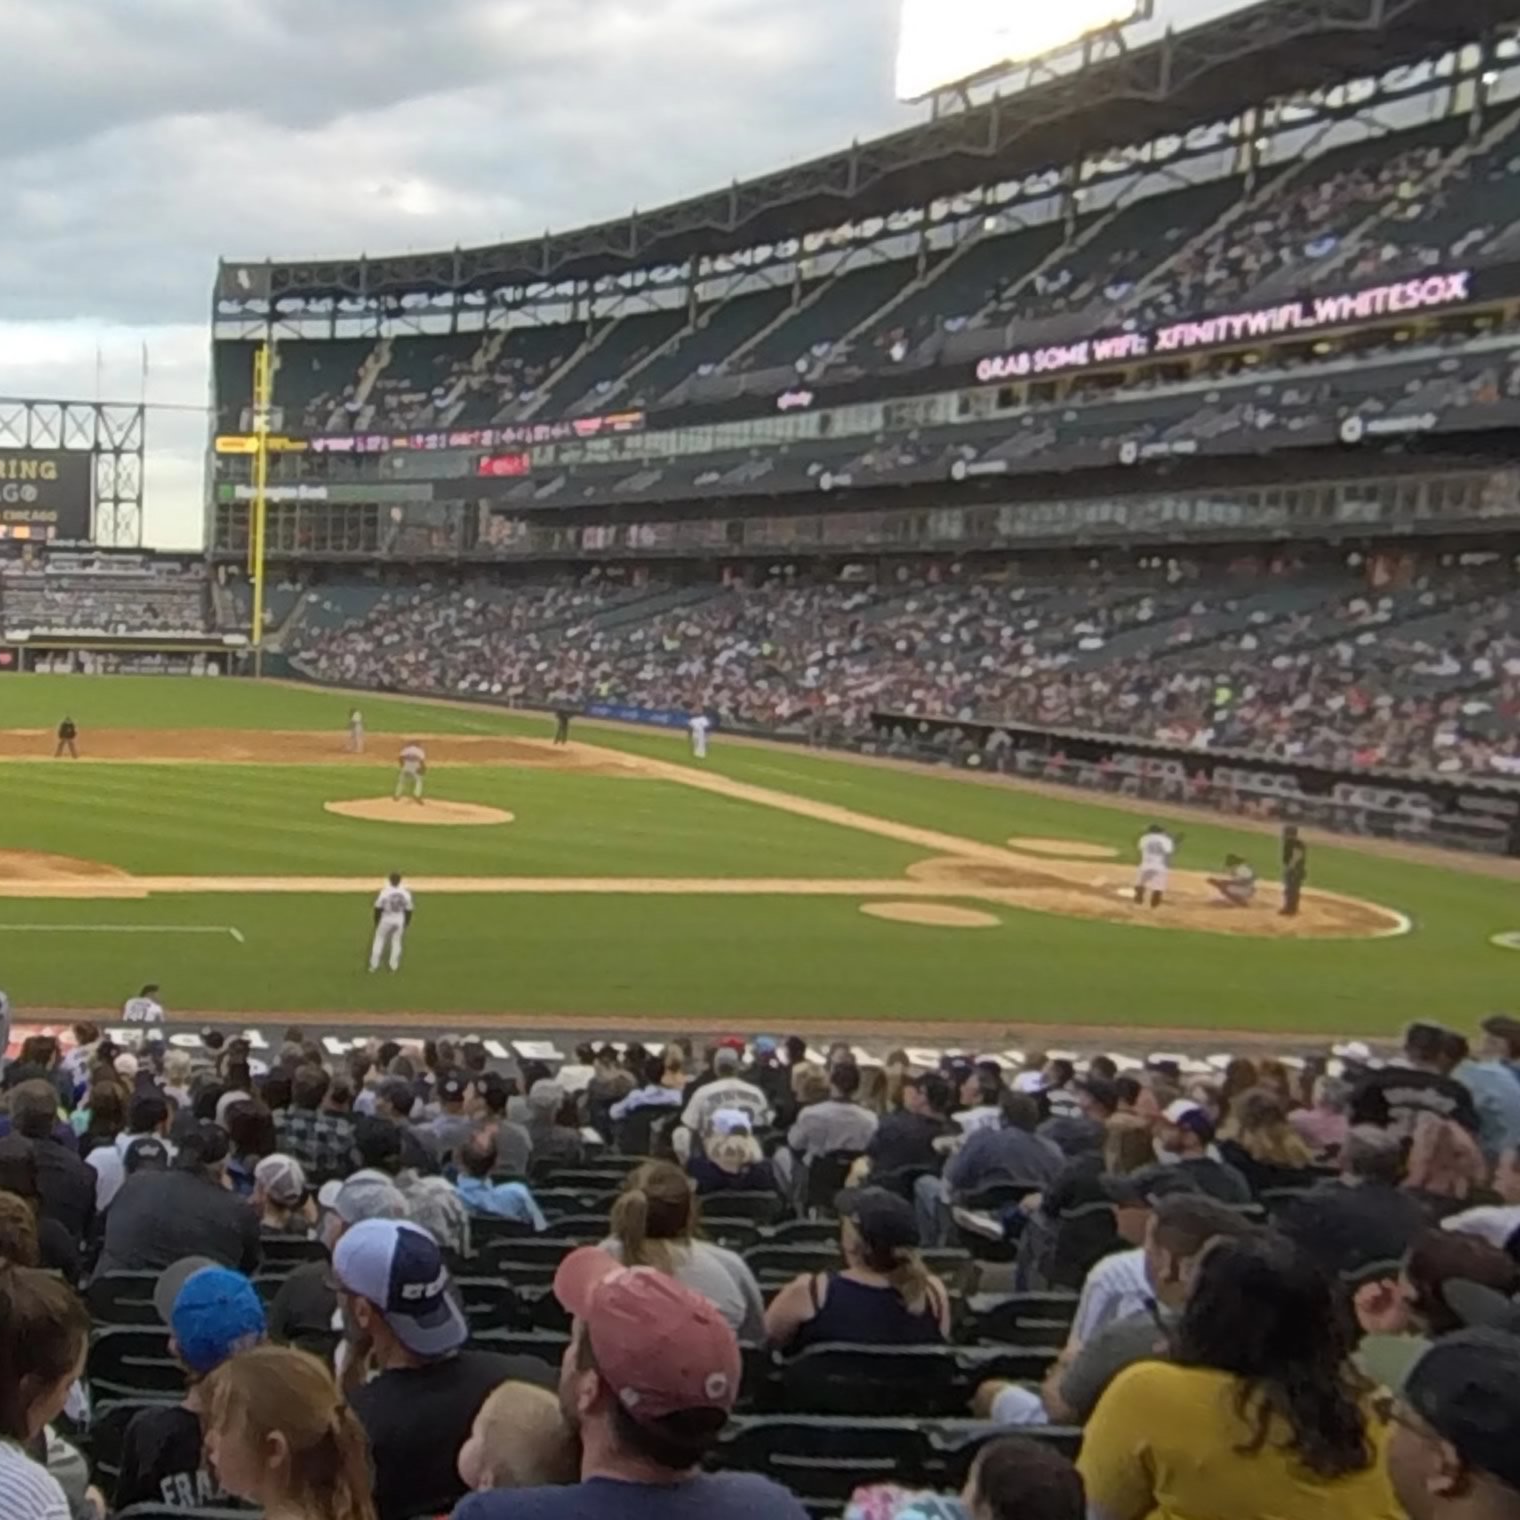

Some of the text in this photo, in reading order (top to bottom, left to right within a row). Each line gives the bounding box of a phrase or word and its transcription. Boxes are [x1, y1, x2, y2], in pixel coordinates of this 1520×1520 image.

[976, 347, 1031, 381] GRAB
[1034, 341, 1089, 374] SOME
[1093, 333, 1147, 361] WIFI:
